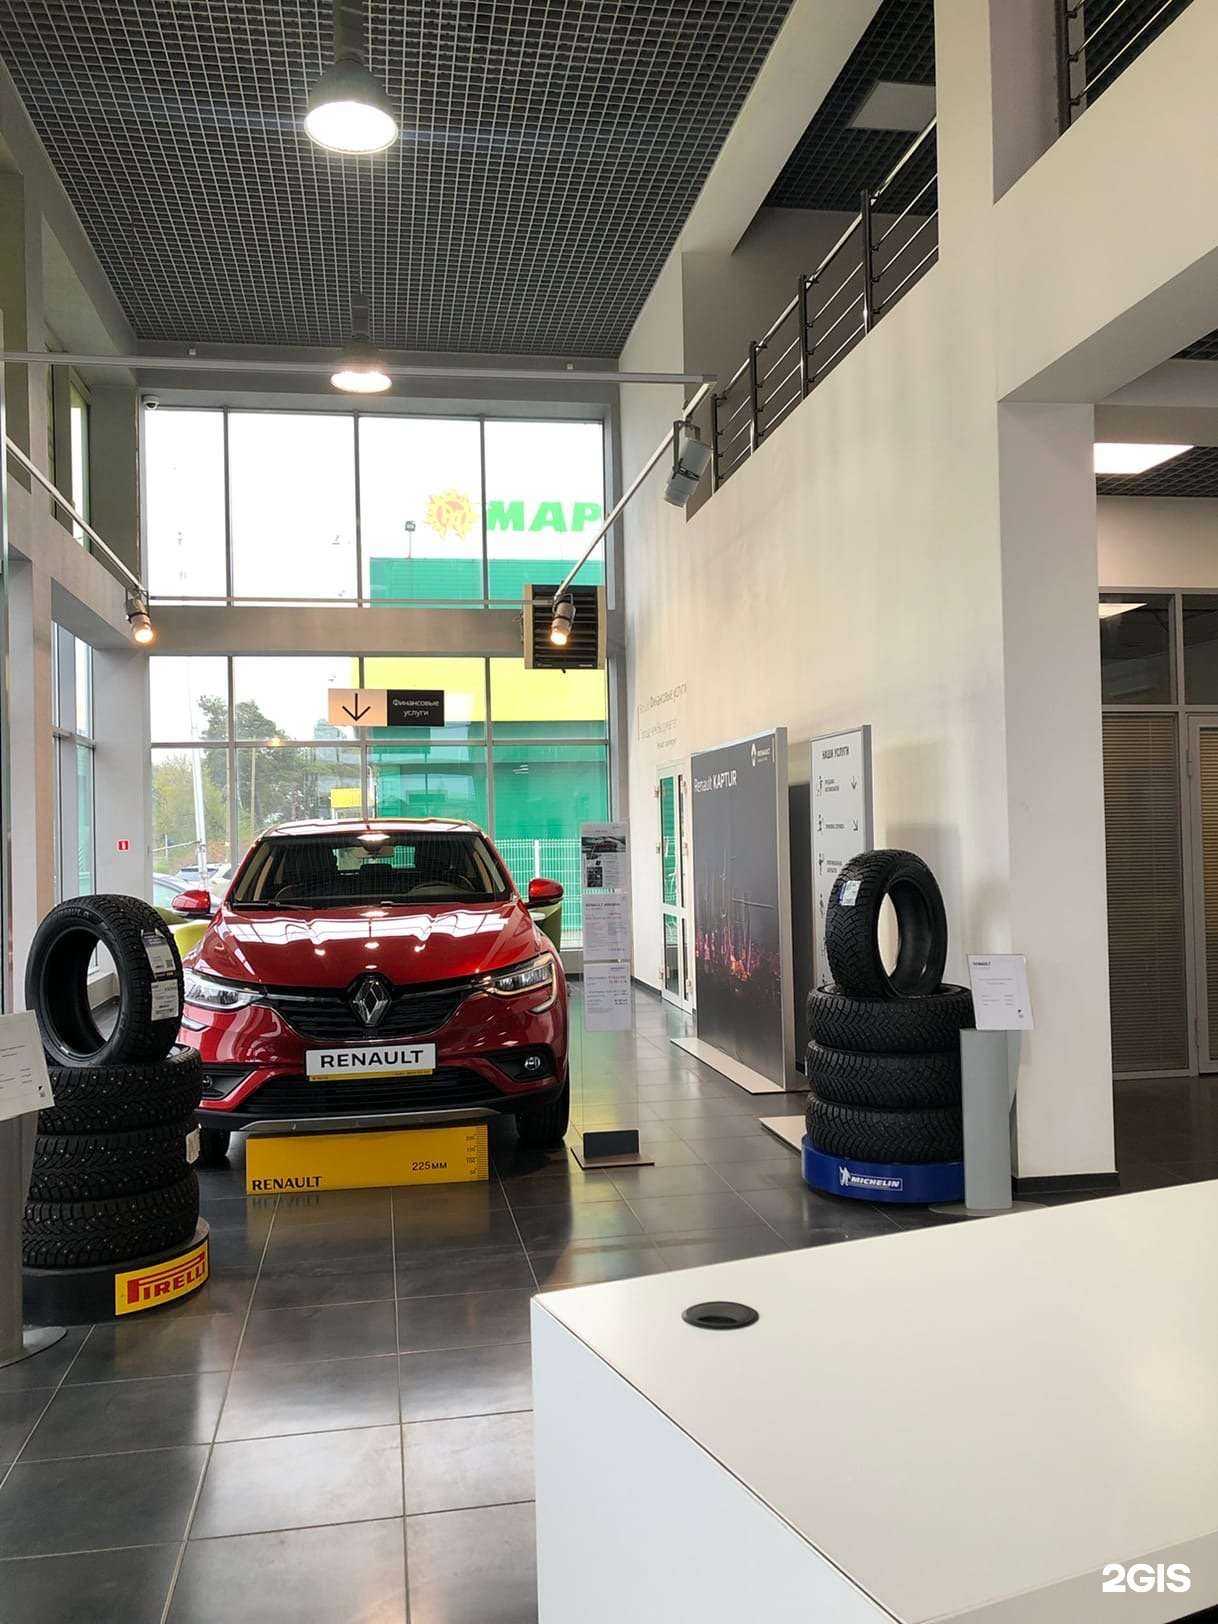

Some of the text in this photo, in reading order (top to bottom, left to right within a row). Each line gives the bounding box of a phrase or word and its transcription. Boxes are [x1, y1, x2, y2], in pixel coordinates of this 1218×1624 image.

[392, 699, 440, 707] Финансовые
[403, 709, 429, 718] услуги
[713, 769, 737, 789] KAPTUR
[320, 1050, 424, 1069] RENAULT
[252, 1175, 323, 1191] RENAULT
[851, 1176, 901, 1188] MICHELIN
